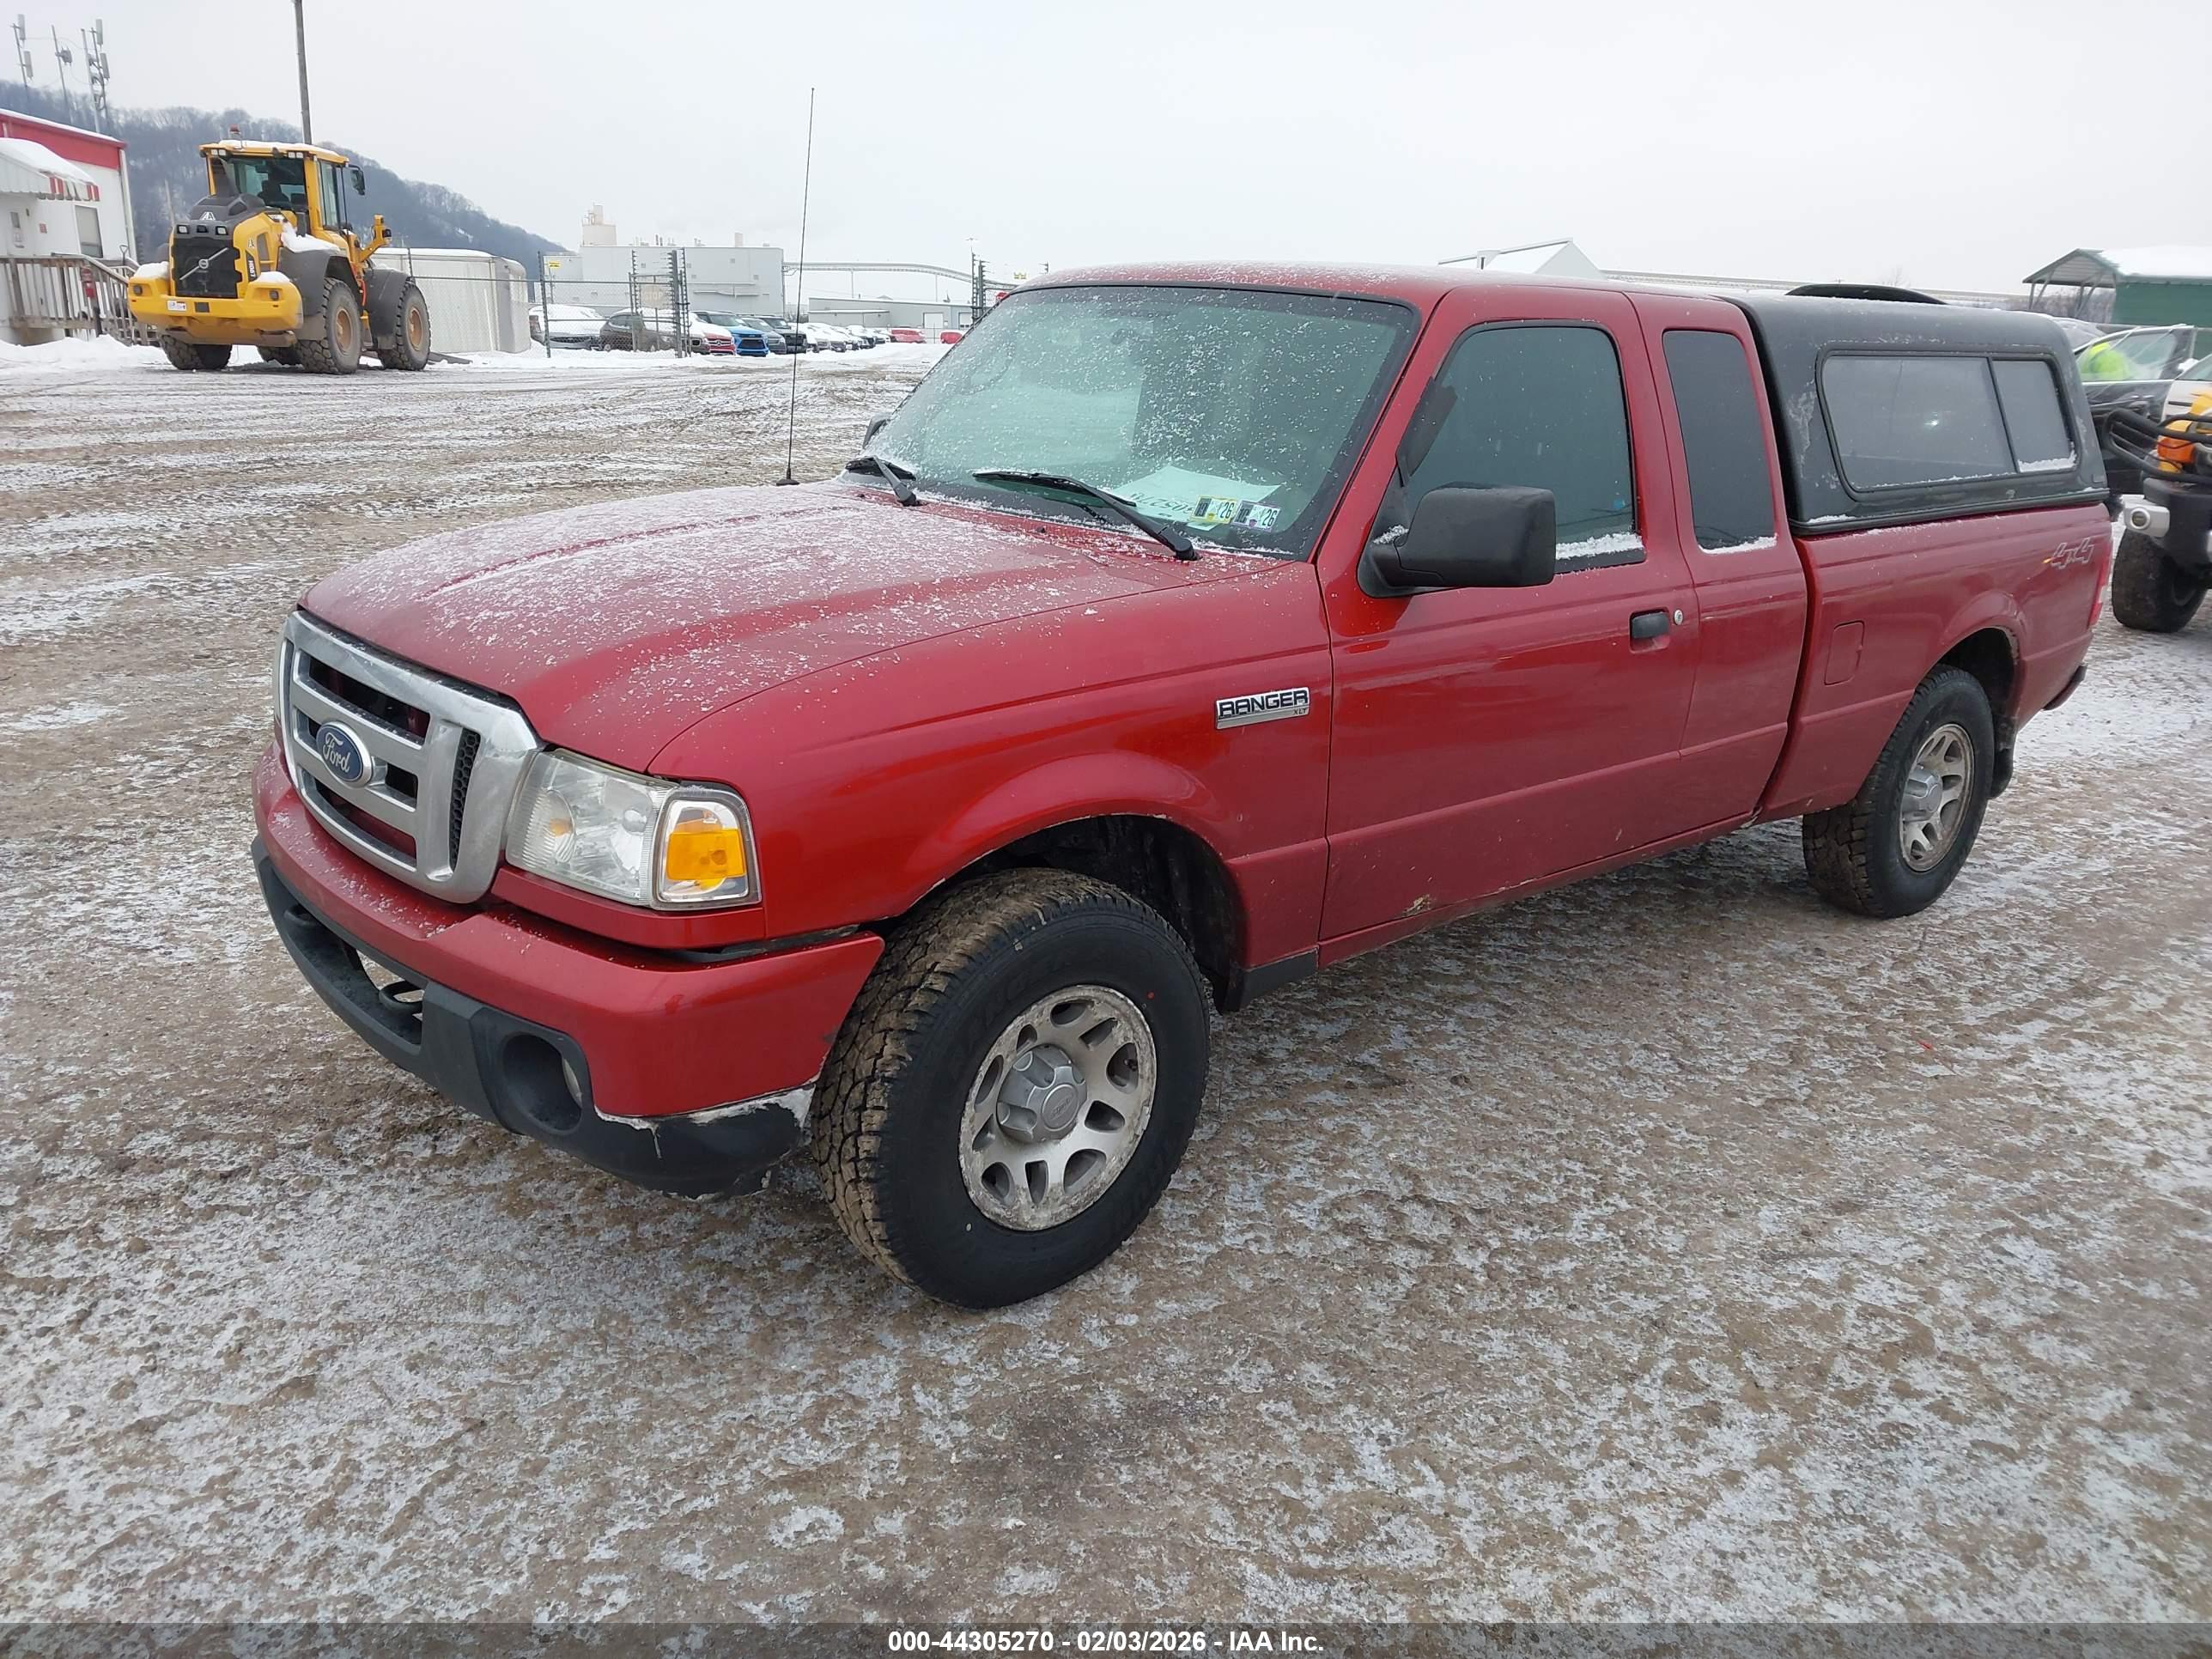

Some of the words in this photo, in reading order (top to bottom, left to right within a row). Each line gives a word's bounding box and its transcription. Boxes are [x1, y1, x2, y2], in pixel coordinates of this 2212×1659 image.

[1219, 501, 1235, 519] 26
[1261, 508, 1278, 526] 26
[1218, 689, 1308, 718] RANGER
[1292, 707, 1308, 715] XLT
[323, 732, 350, 773] Ford
